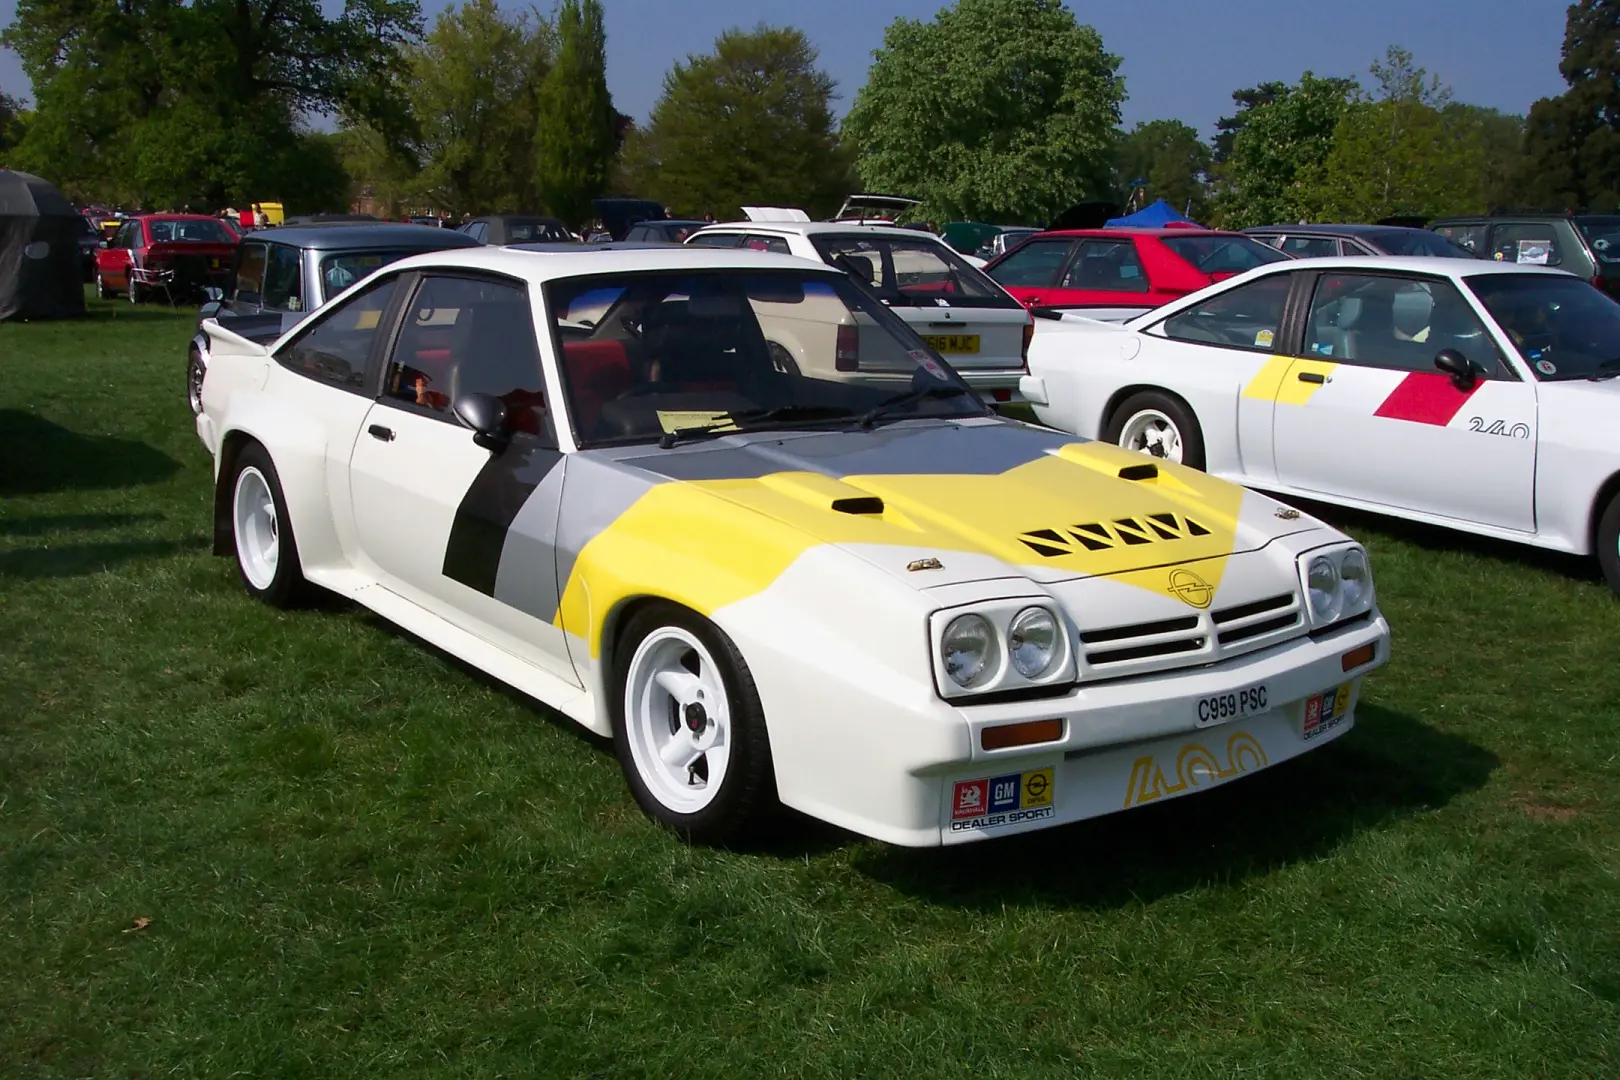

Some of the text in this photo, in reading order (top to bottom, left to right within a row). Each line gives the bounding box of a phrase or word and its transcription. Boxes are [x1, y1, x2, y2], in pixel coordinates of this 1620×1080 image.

[1469, 416, 1530, 440] 240
[1198, 685, 1268, 722] C959 PSC
[995, 782, 1015, 800] GM
[952, 808, 1051, 831] DEALER SPORT
